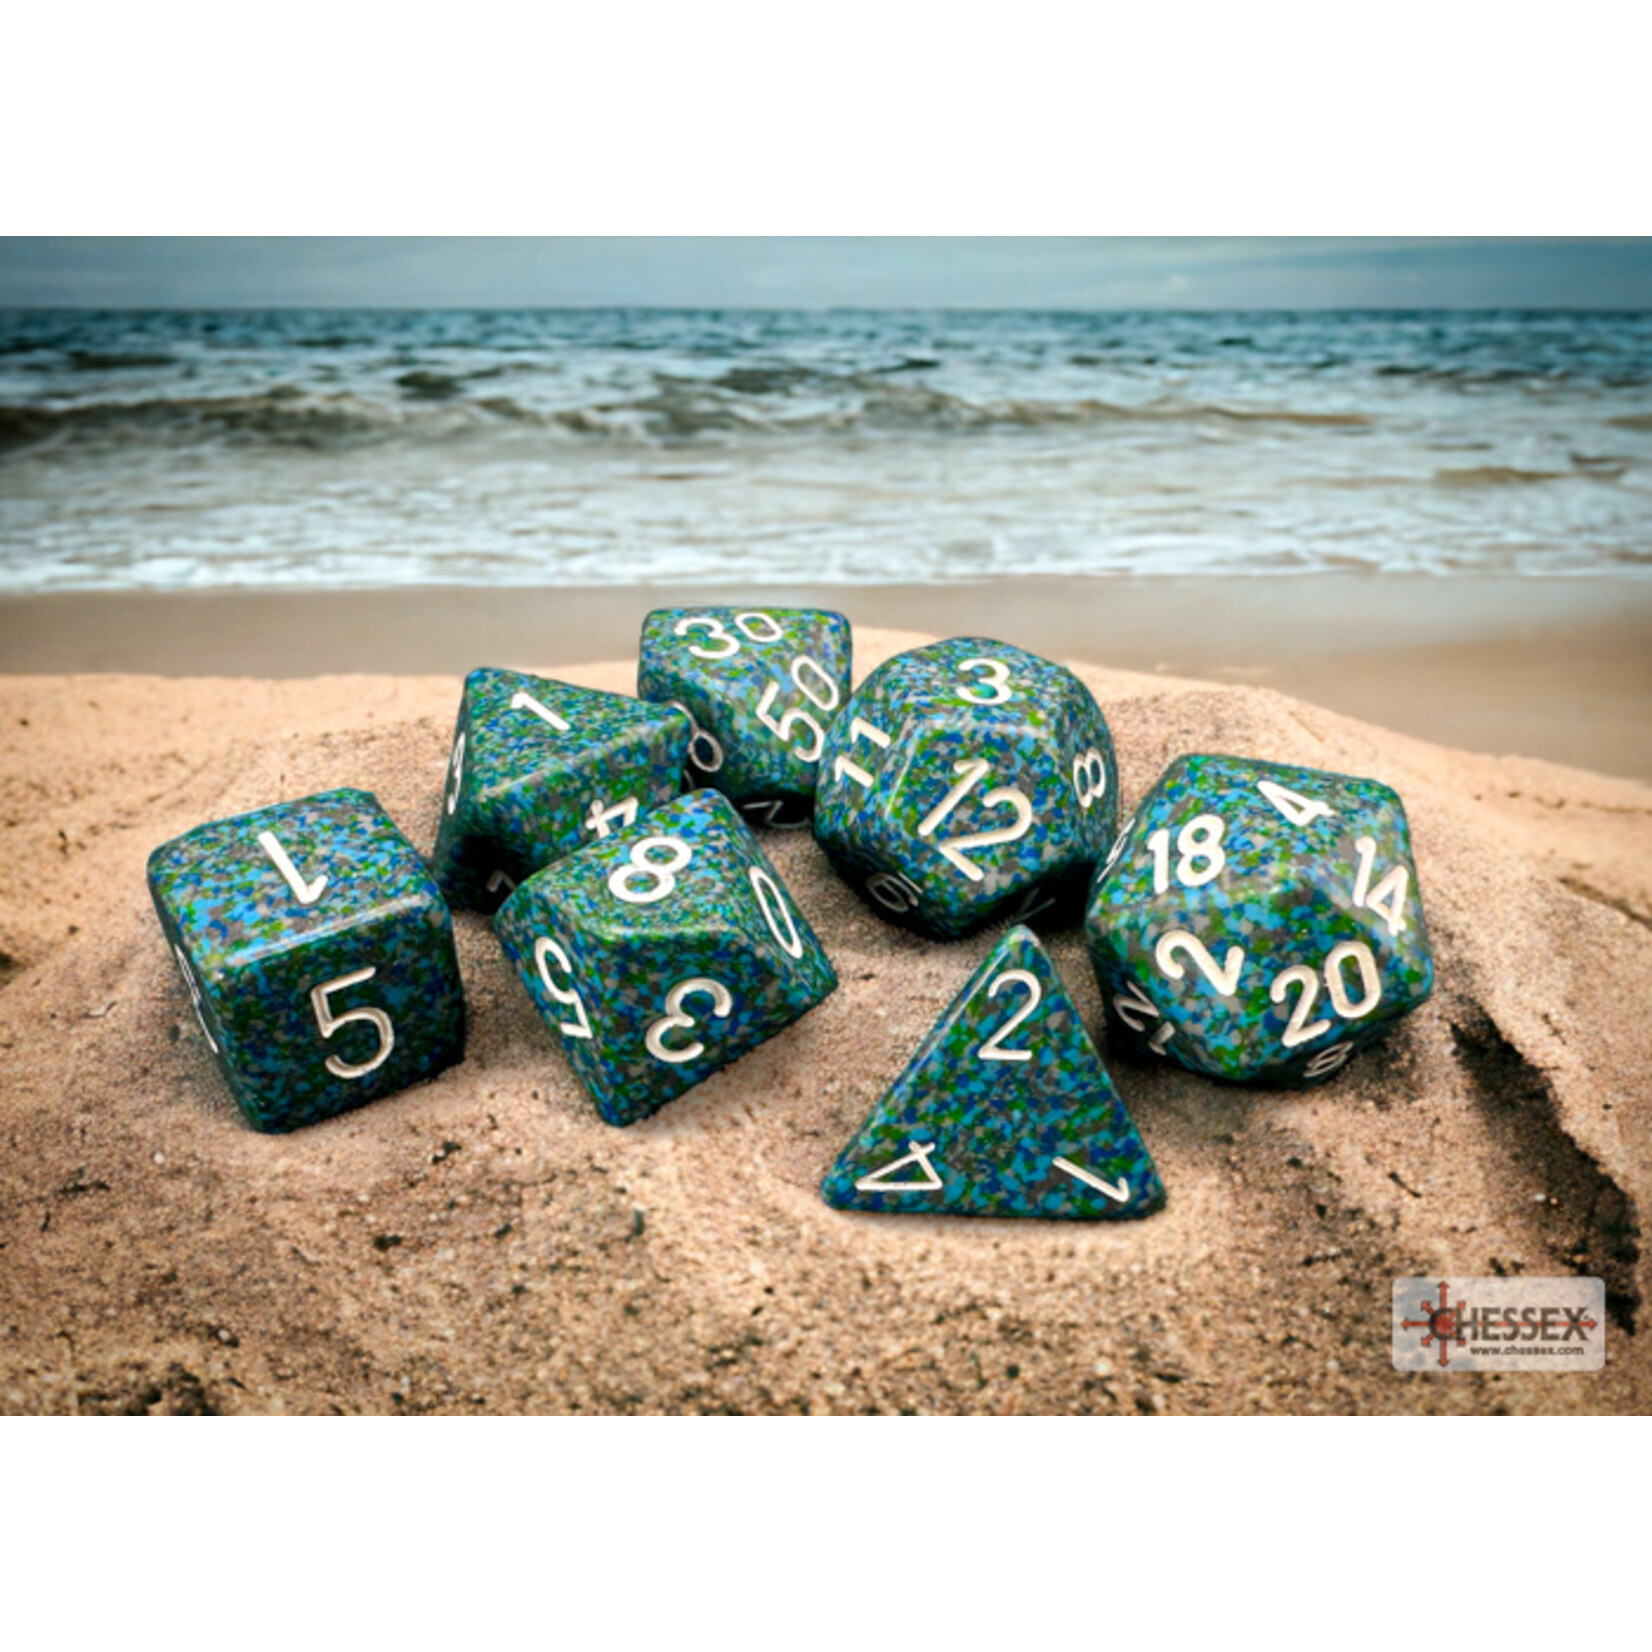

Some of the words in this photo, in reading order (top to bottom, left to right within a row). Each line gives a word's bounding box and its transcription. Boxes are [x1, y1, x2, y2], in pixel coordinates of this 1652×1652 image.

[674, 612, 784, 660] 30
[511, 692, 571, 732] 1
[755, 655, 840, 763] 50
[955, 658, 1012, 705] 3
[834, 717, 891, 788] 11
[1073, 746, 1106, 808] 8
[918, 757, 1033, 881] 12
[1257, 780, 1336, 827] 4
[258, 830, 329, 905] 1
[608, 836, 692, 903] 8
[1147, 814, 1226, 895] 18
[1352, 835, 1409, 937] 14
[750, 866, 803, 960] 0
[534, 936, 594, 1040] 5
[1155, 930, 1245, 997] 2
[1270, 941, 1381, 1048] 20
[310, 966, 395, 1080] 5
[646, 976, 733, 1064] 3
[978, 969, 1042, 1061] 2
[855, 1140, 944, 1191] 4
[1052, 1156, 1130, 1203] 1
